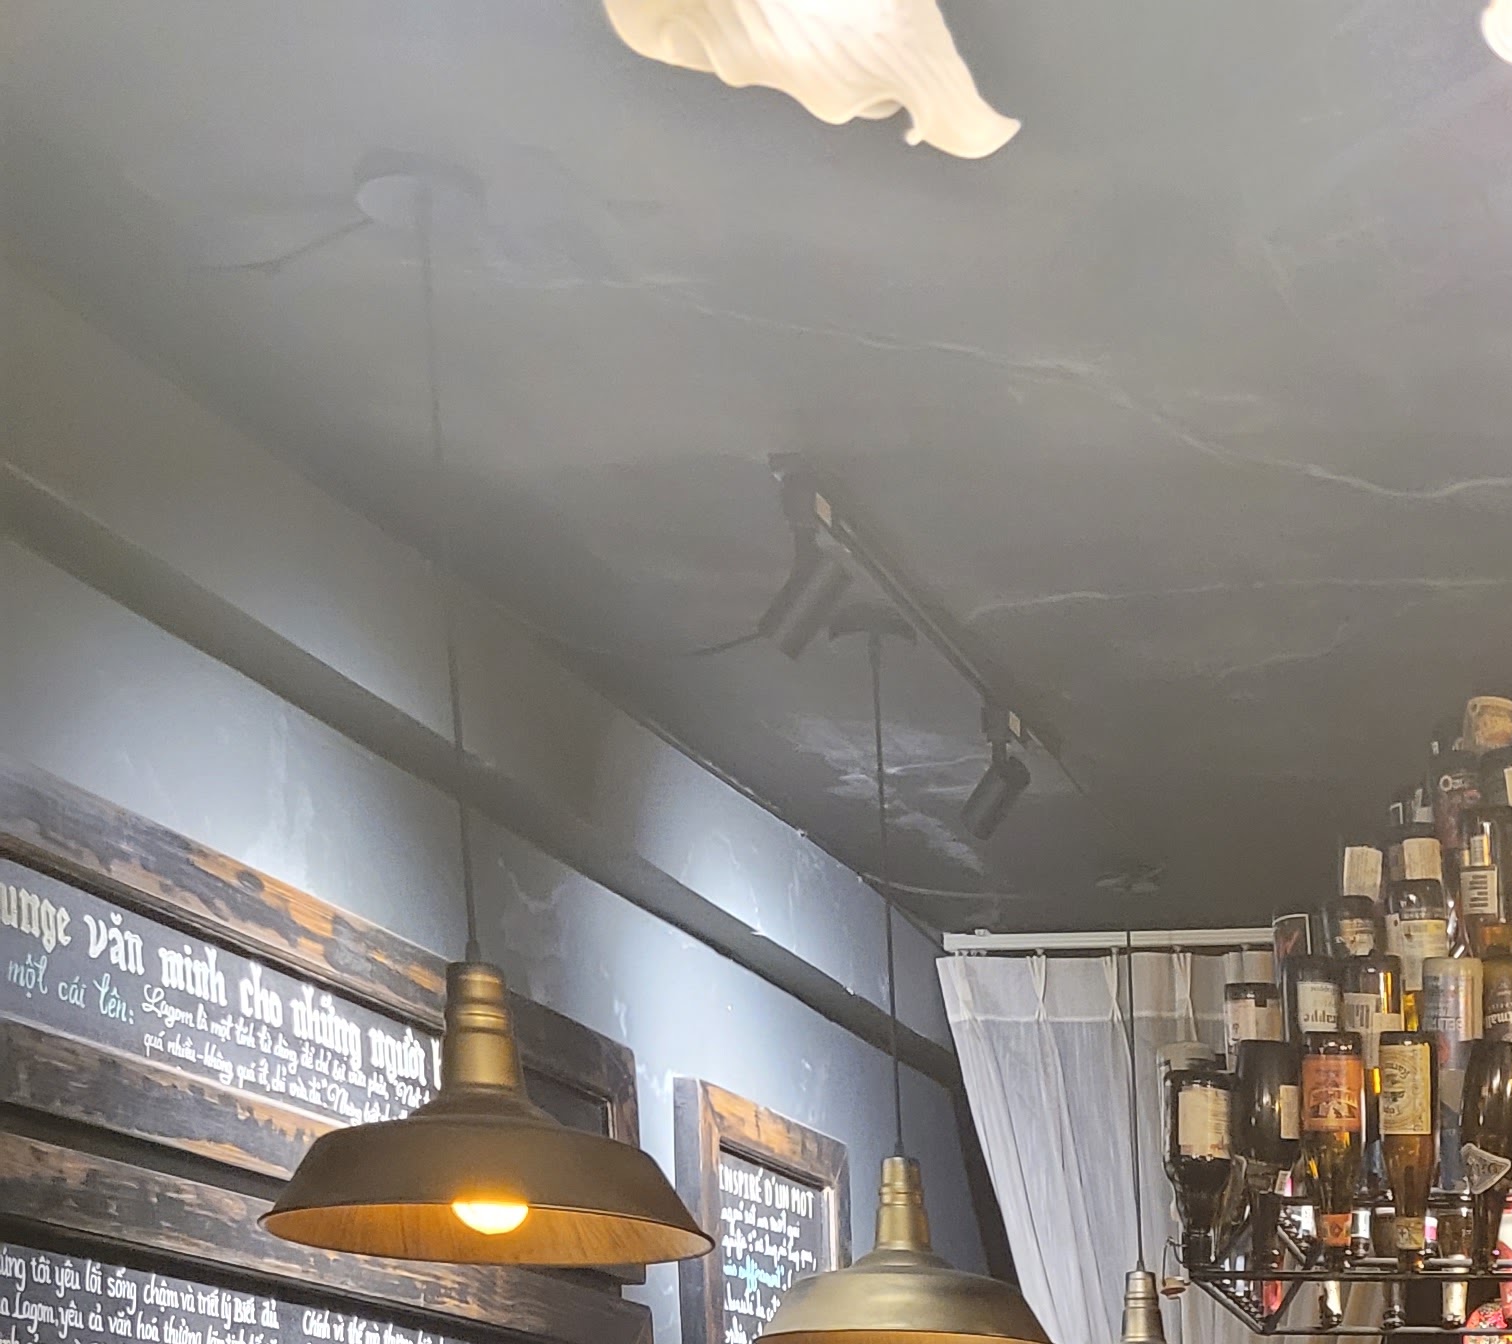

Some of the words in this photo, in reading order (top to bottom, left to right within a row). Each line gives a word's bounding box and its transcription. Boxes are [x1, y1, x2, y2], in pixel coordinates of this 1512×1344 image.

[8, 954, 48, 998] một
[58, 976, 86, 1008] cái
[93, 973, 135, 1024] tên:
[141, 984, 195, 1028] Lagom
[158, 945, 228, 1007] minh
[239, 962, 282, 1028] cho
[144, 1031, 165, 1057] quá
[719, 1164, 763, 1204] INSPIRÉ
[764, 1176, 789, 1210] D'UN
[791, 1187, 816, 1219] MOT
[30, 1256, 52, 1284] tôi
[55, 1259, 81, 1298] yêu
[107, 1267, 137, 1315] sống
[143, 1273, 179, 1312] chậm
[180, 1284, 196, 1313] và
[260, 1299, 280, 1330] đủ
[58, 1300, 85, 1339] yêu
[88, 1302, 105, 1332] cả
[107, 1310, 132, 1338] văn
